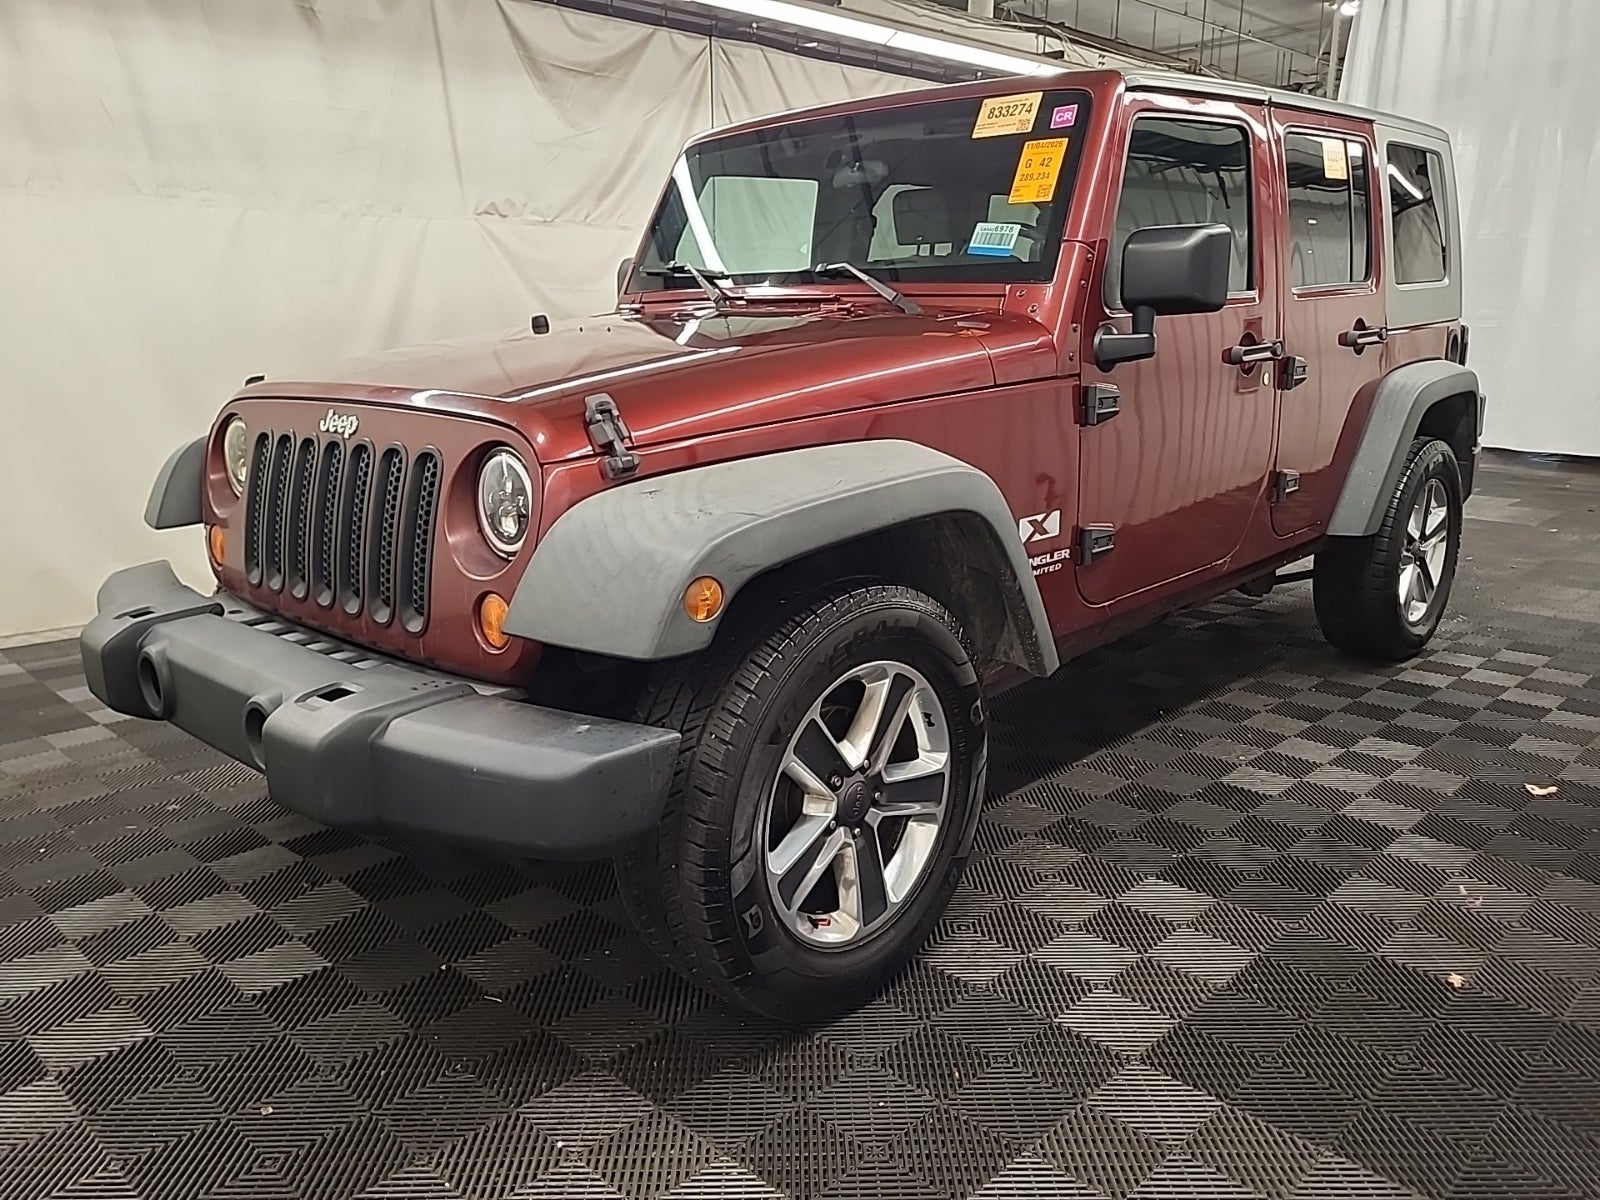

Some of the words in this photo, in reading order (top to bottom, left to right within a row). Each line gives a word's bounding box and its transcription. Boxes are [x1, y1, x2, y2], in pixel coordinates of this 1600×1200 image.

[987, 102, 1033, 119] 833274
[1055, 111, 1072, 122] CR
[1025, 158, 1033, 169] G
[1039, 157, 1053, 168] 42
[319, 408, 359, 439] Jeep
[1020, 510, 1057, 544] X
[1028, 548, 1071, 567] NGLER
[1032, 563, 1062, 576] MITED
[852, 786, 865, 815] Jeep
